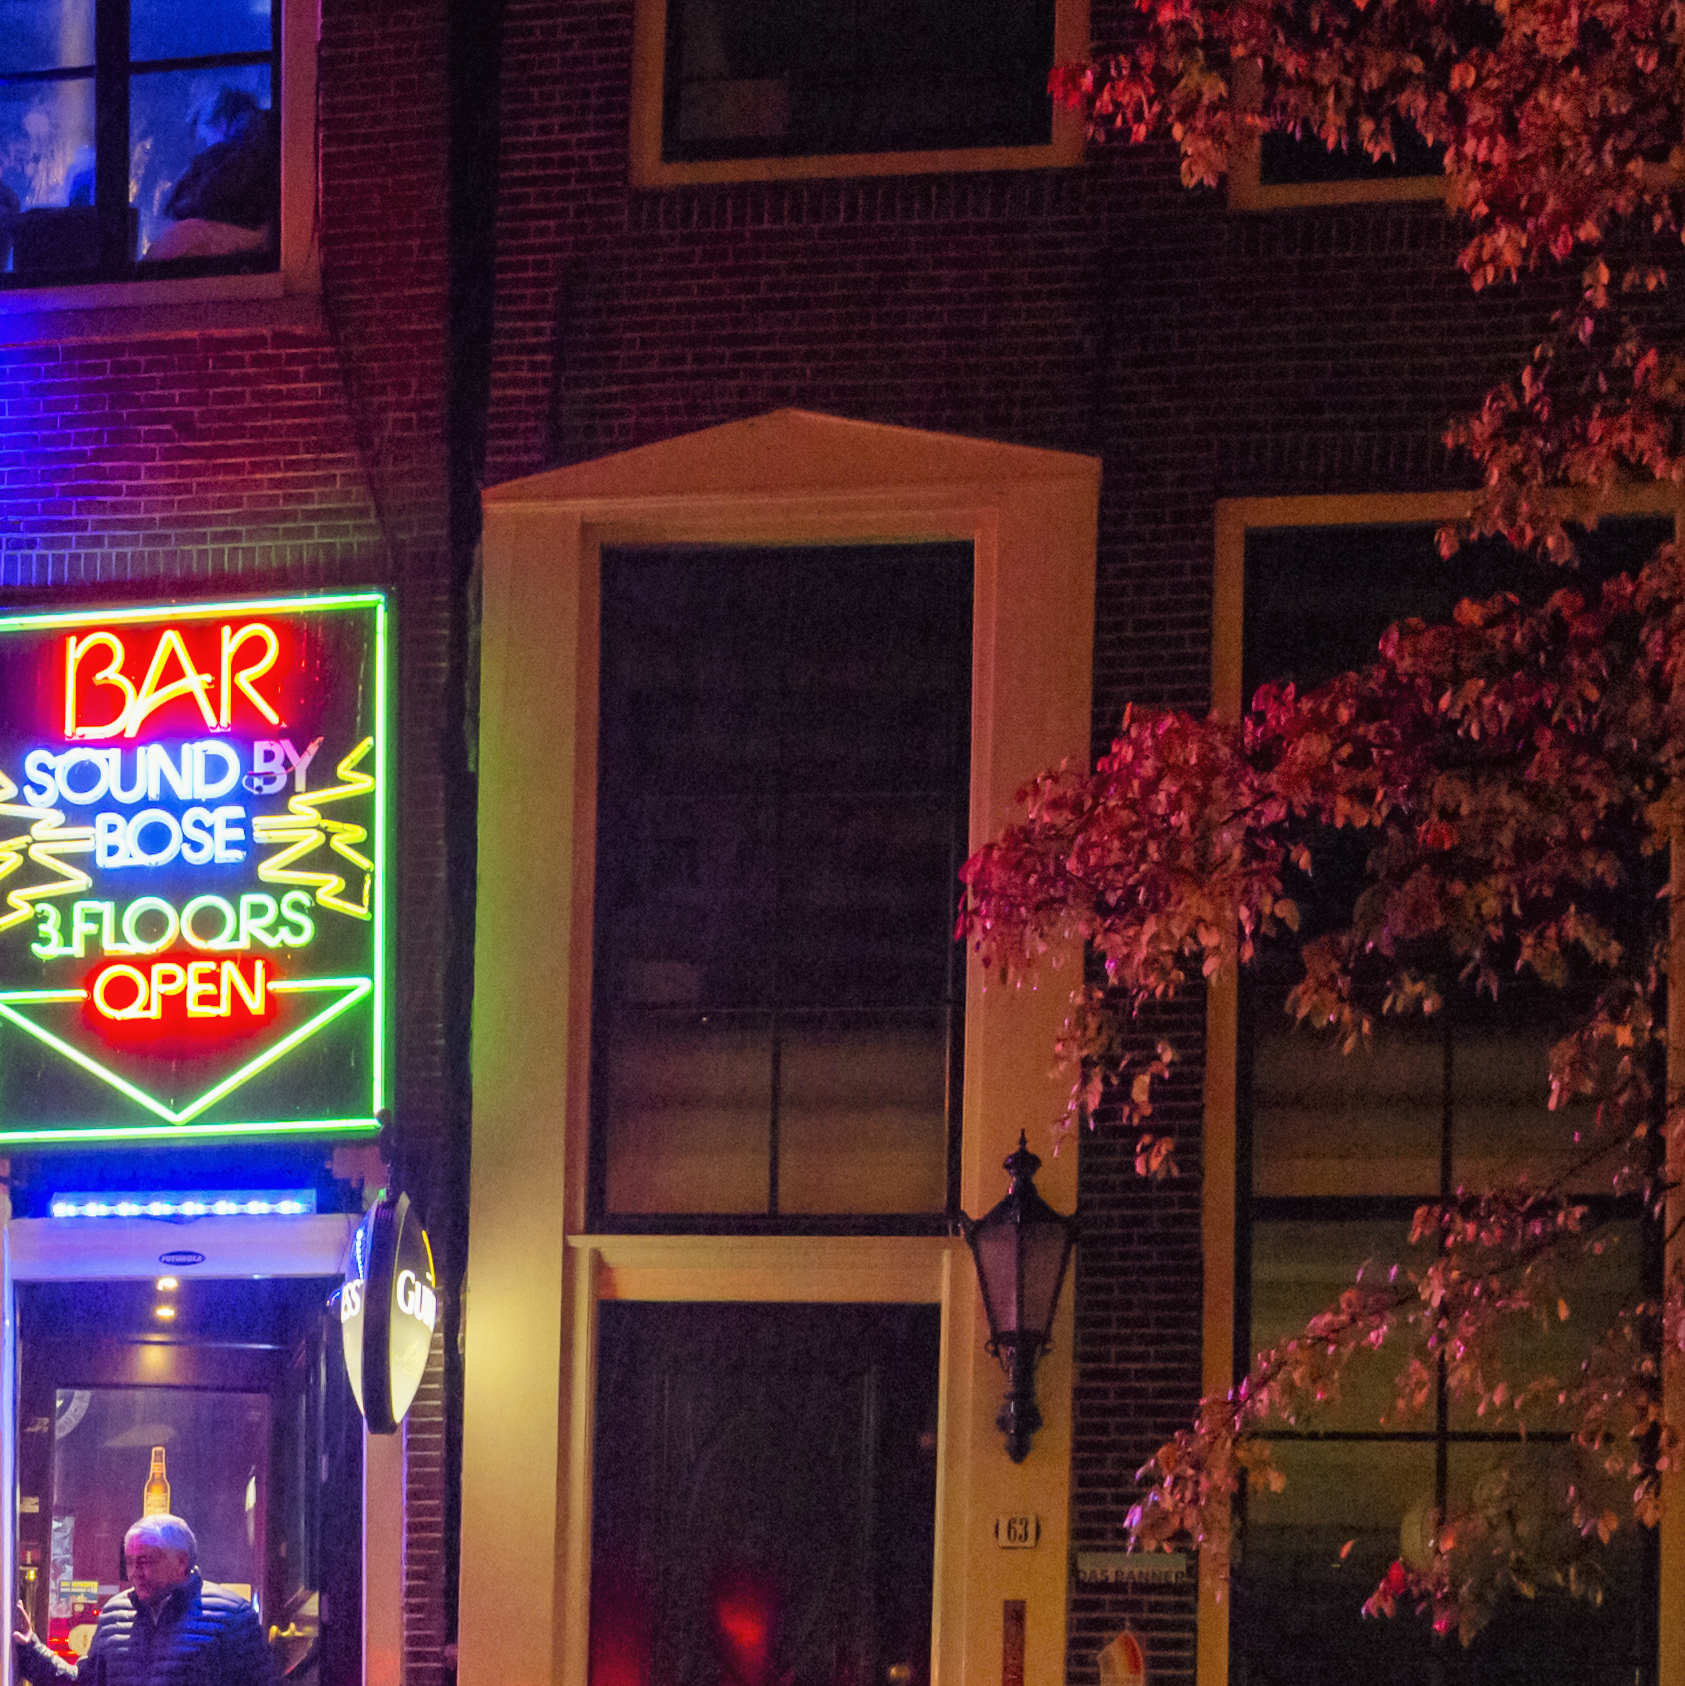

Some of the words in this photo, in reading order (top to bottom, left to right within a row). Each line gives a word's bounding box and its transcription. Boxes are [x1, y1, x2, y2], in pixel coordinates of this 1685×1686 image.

[64, 621, 282, 741] BAR
[23, 738, 241, 808] SOUND
[251, 738, 323, 795] BY
[94, 805, 247, 869] BOSE
[72, 890, 316, 959] FLOORS
[93, 959, 267, 1021] OPEN
[1006, 1516, 1030, 1543] 63
